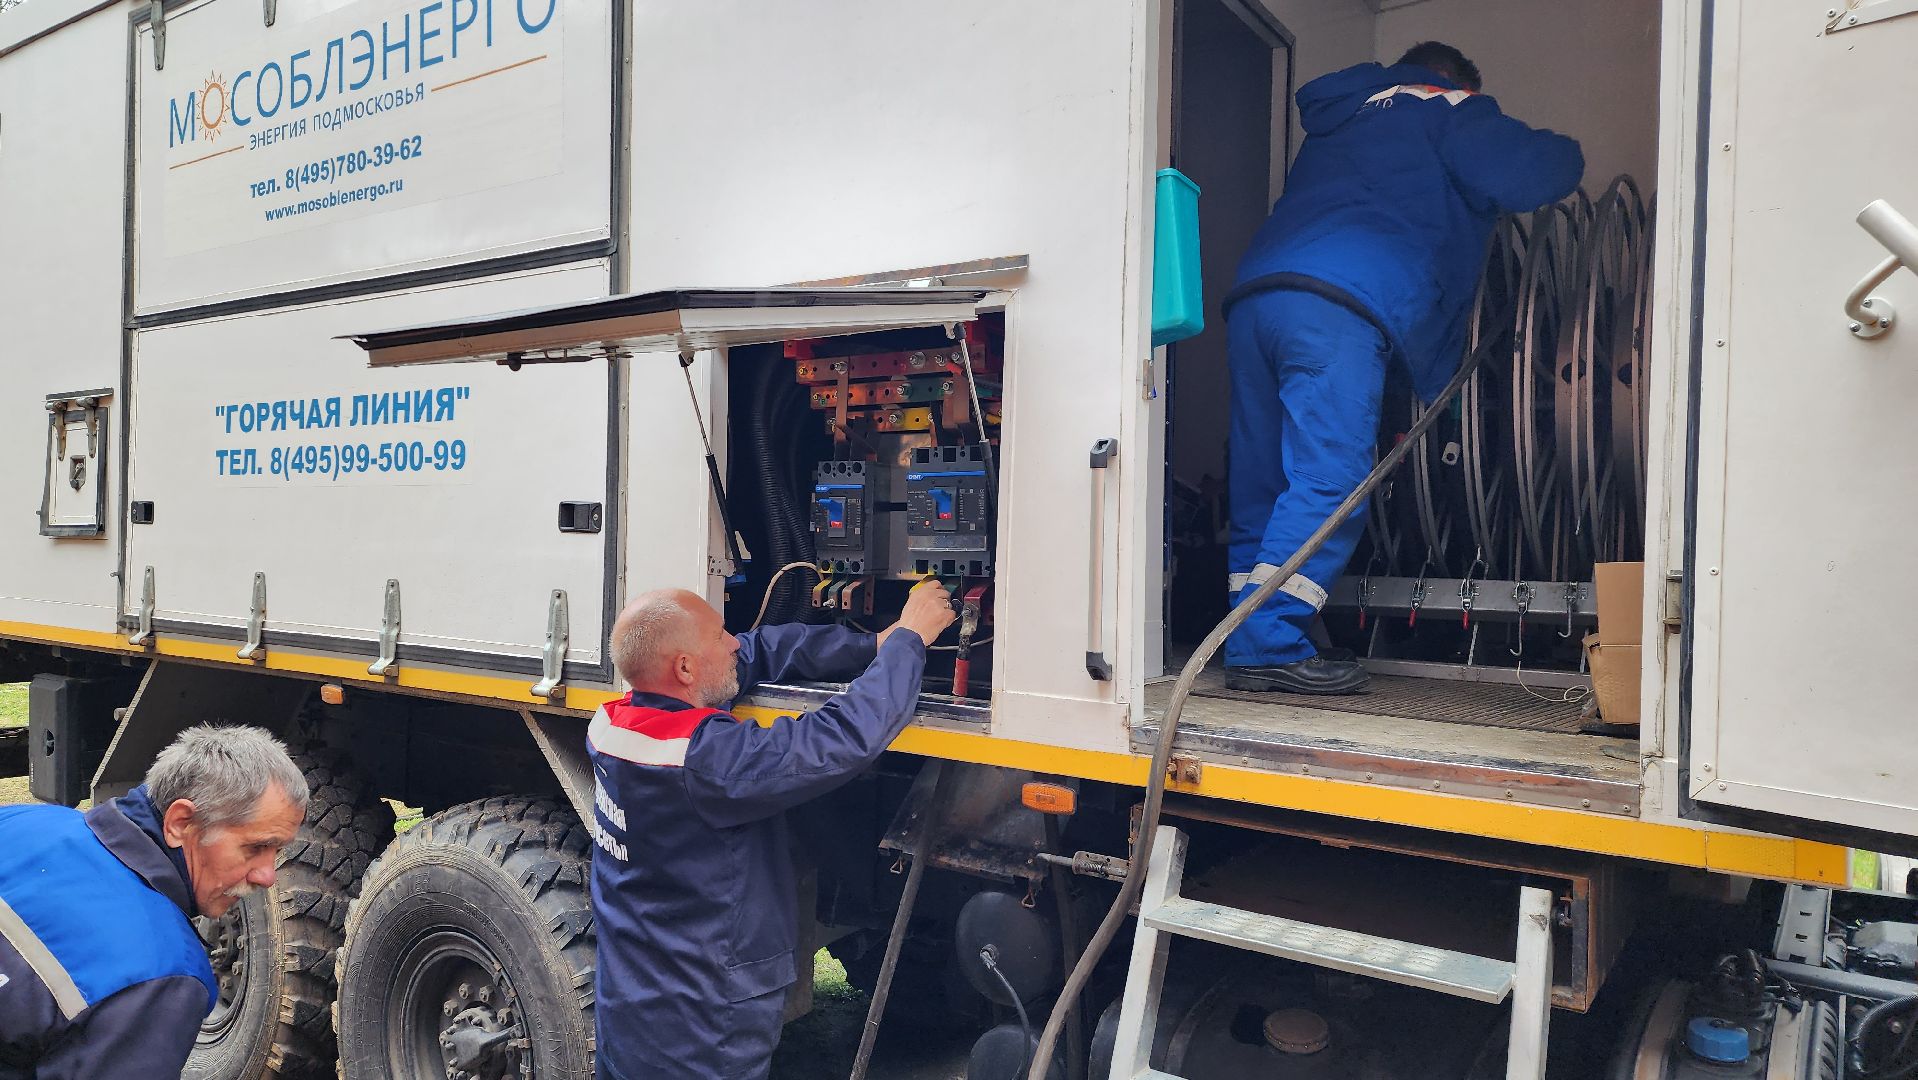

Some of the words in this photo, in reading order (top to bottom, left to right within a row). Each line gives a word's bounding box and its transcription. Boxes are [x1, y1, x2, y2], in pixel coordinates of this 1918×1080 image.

[249, 118, 307, 151] ЭНЕРГИЯ
[312, 82, 424, 131] ПОДМОСКОВЬЯ
[250, 178, 281, 198] тел.
[285, 134, 422, 192] 8(495)780-39-62
[265, 179, 403, 221] www.mosoblenergo.ru
[215, 396, 341, 433] "ГОРЯЧАЯ
[349, 386, 470, 426] ЛИНИЯ"
[215, 448, 263, 476] ТЕЛ.
[270, 439, 466, 482] 8(495)99-500-99
